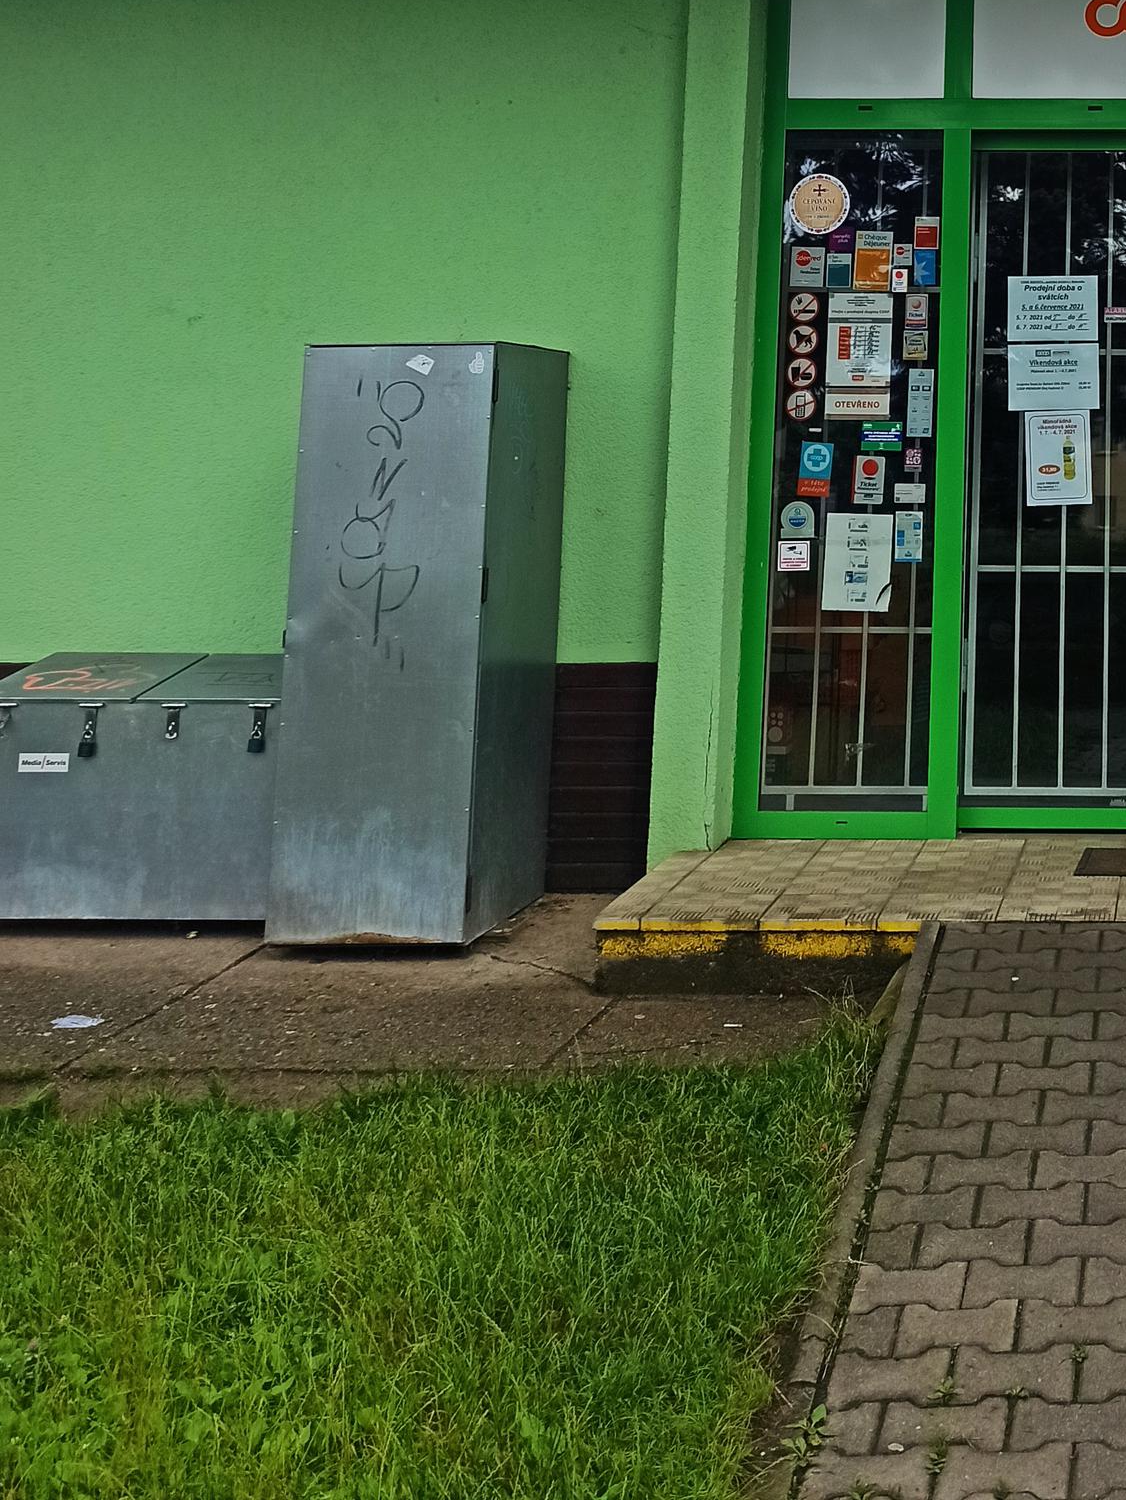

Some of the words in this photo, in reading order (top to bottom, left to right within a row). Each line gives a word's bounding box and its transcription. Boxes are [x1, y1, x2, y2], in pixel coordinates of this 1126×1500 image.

[1024, 284, 1055, 293] Prodejní
[1029, 359, 1062, 367] Víkendová
[1063, 359, 1078, 367] akce
[835, 400, 880, 409] OTEVŘENO
[21, 759, 42, 767] Media
[45, 759, 67, 767] Servis
